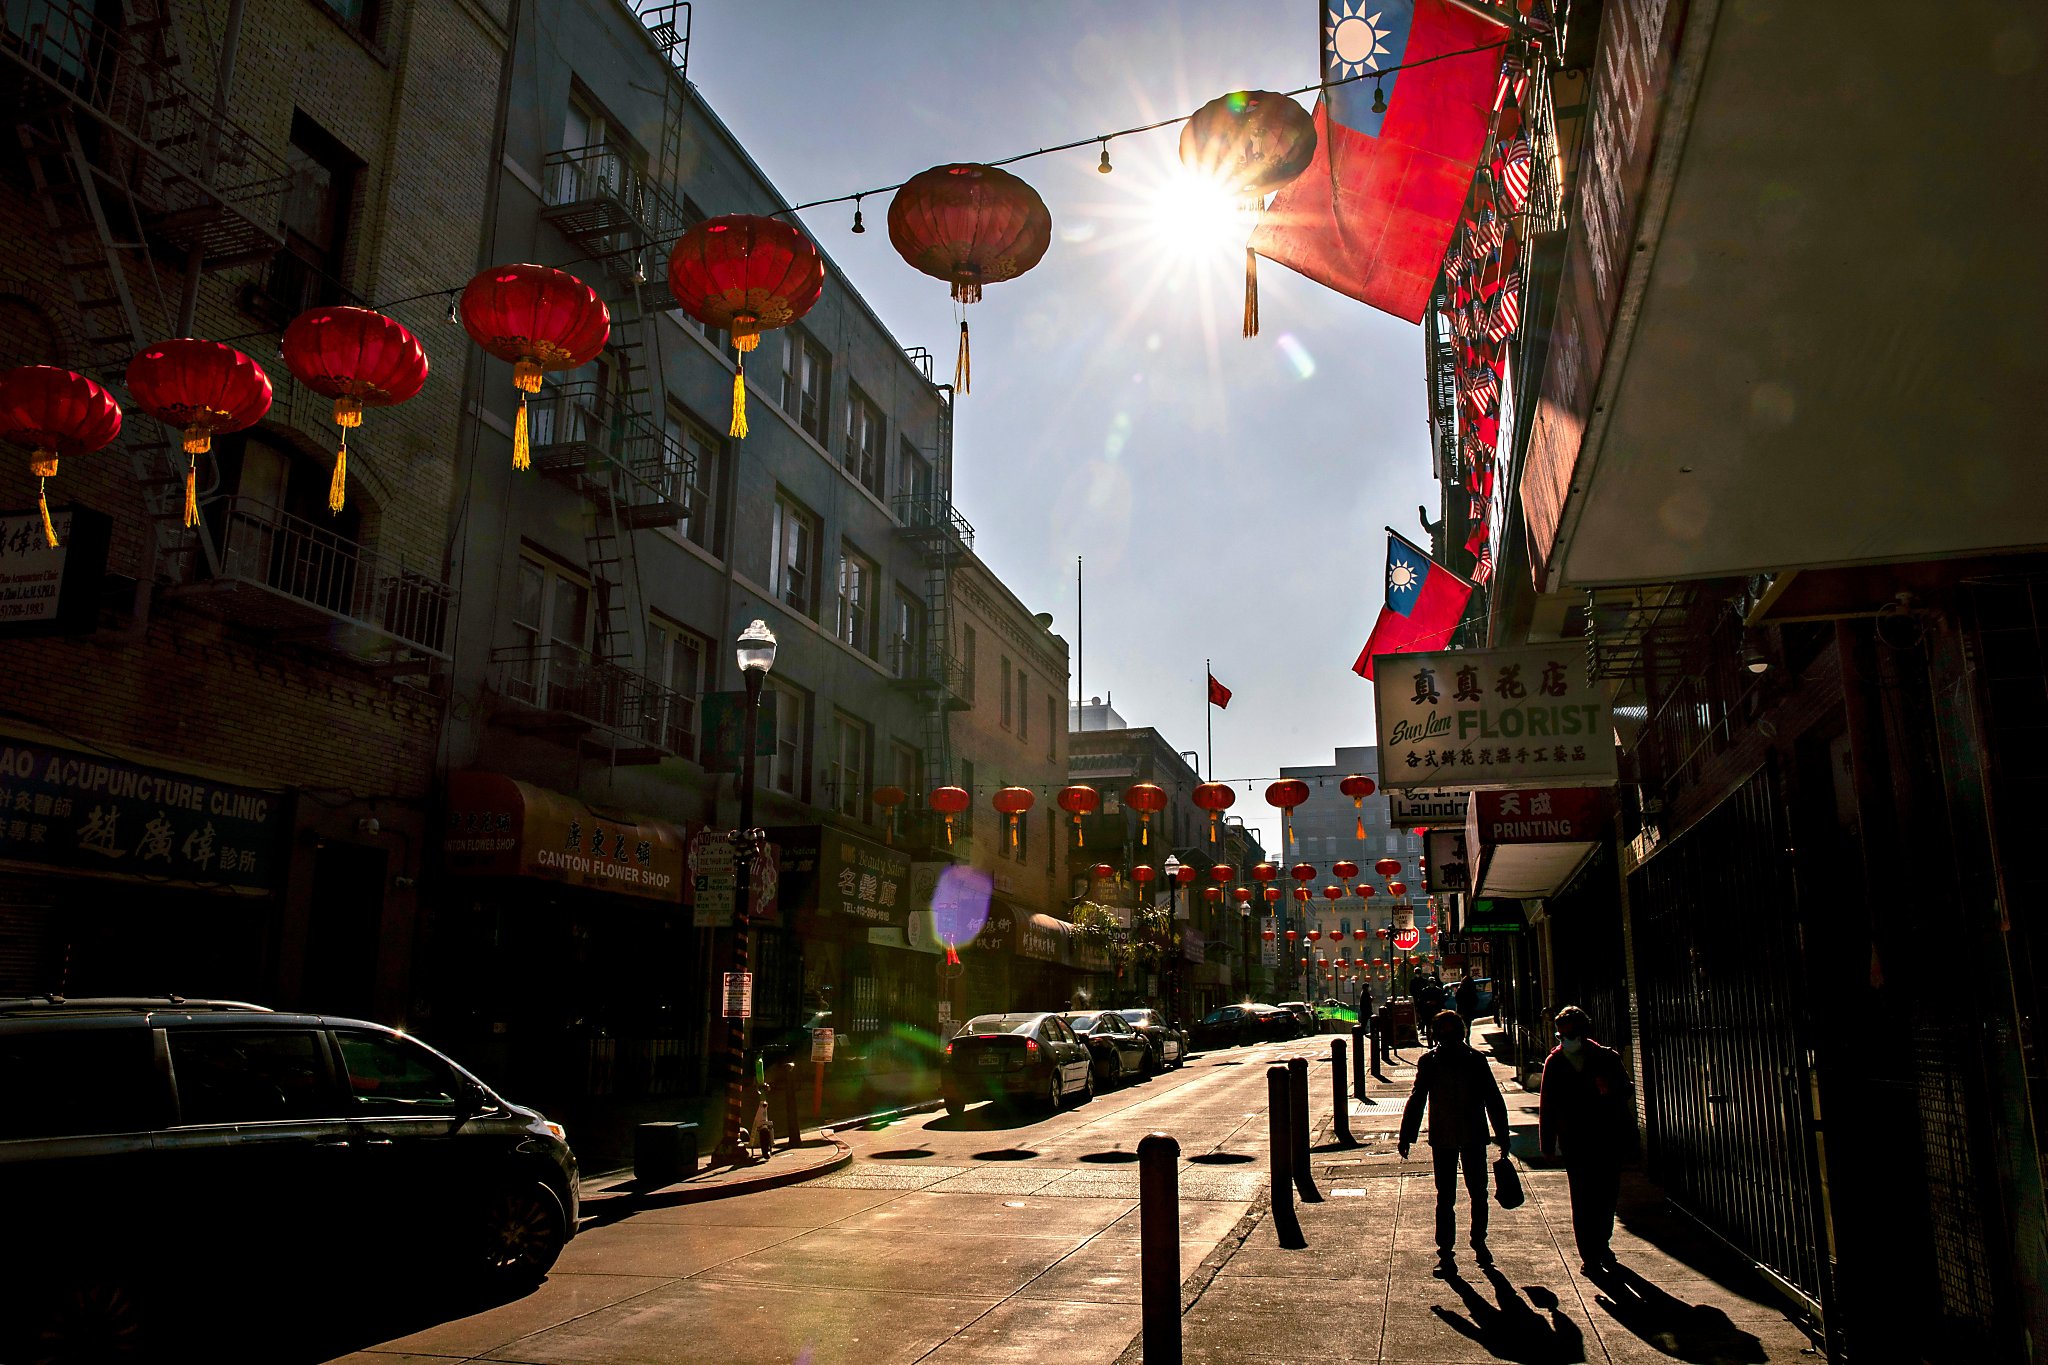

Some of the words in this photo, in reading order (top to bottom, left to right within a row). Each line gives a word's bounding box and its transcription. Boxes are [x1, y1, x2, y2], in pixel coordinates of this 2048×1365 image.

[1410, 661, 1568, 705] 真真花店
[1390, 719, 1422, 746] Sun
[1458, 704, 1601, 740] FLORIST
[44, 756, 206, 812] ACUPUNCTURE
[210, 789, 268, 823] CLINIC
[1498, 792, 1552, 817] 天成
[1493, 818, 1572, 839] PRINTING
[466, 838, 494, 851] FLOWER
[495, 837, 515, 850] SHOP
[538, 849, 590, 873] CANTON
[593, 860, 638, 882] FLOWER
[641, 871, 670, 888] SHOP
[698, 879, 706, 889] 2
[1394, 931, 1417, 942] STOP
[1448, 941, 1490, 955] KING
